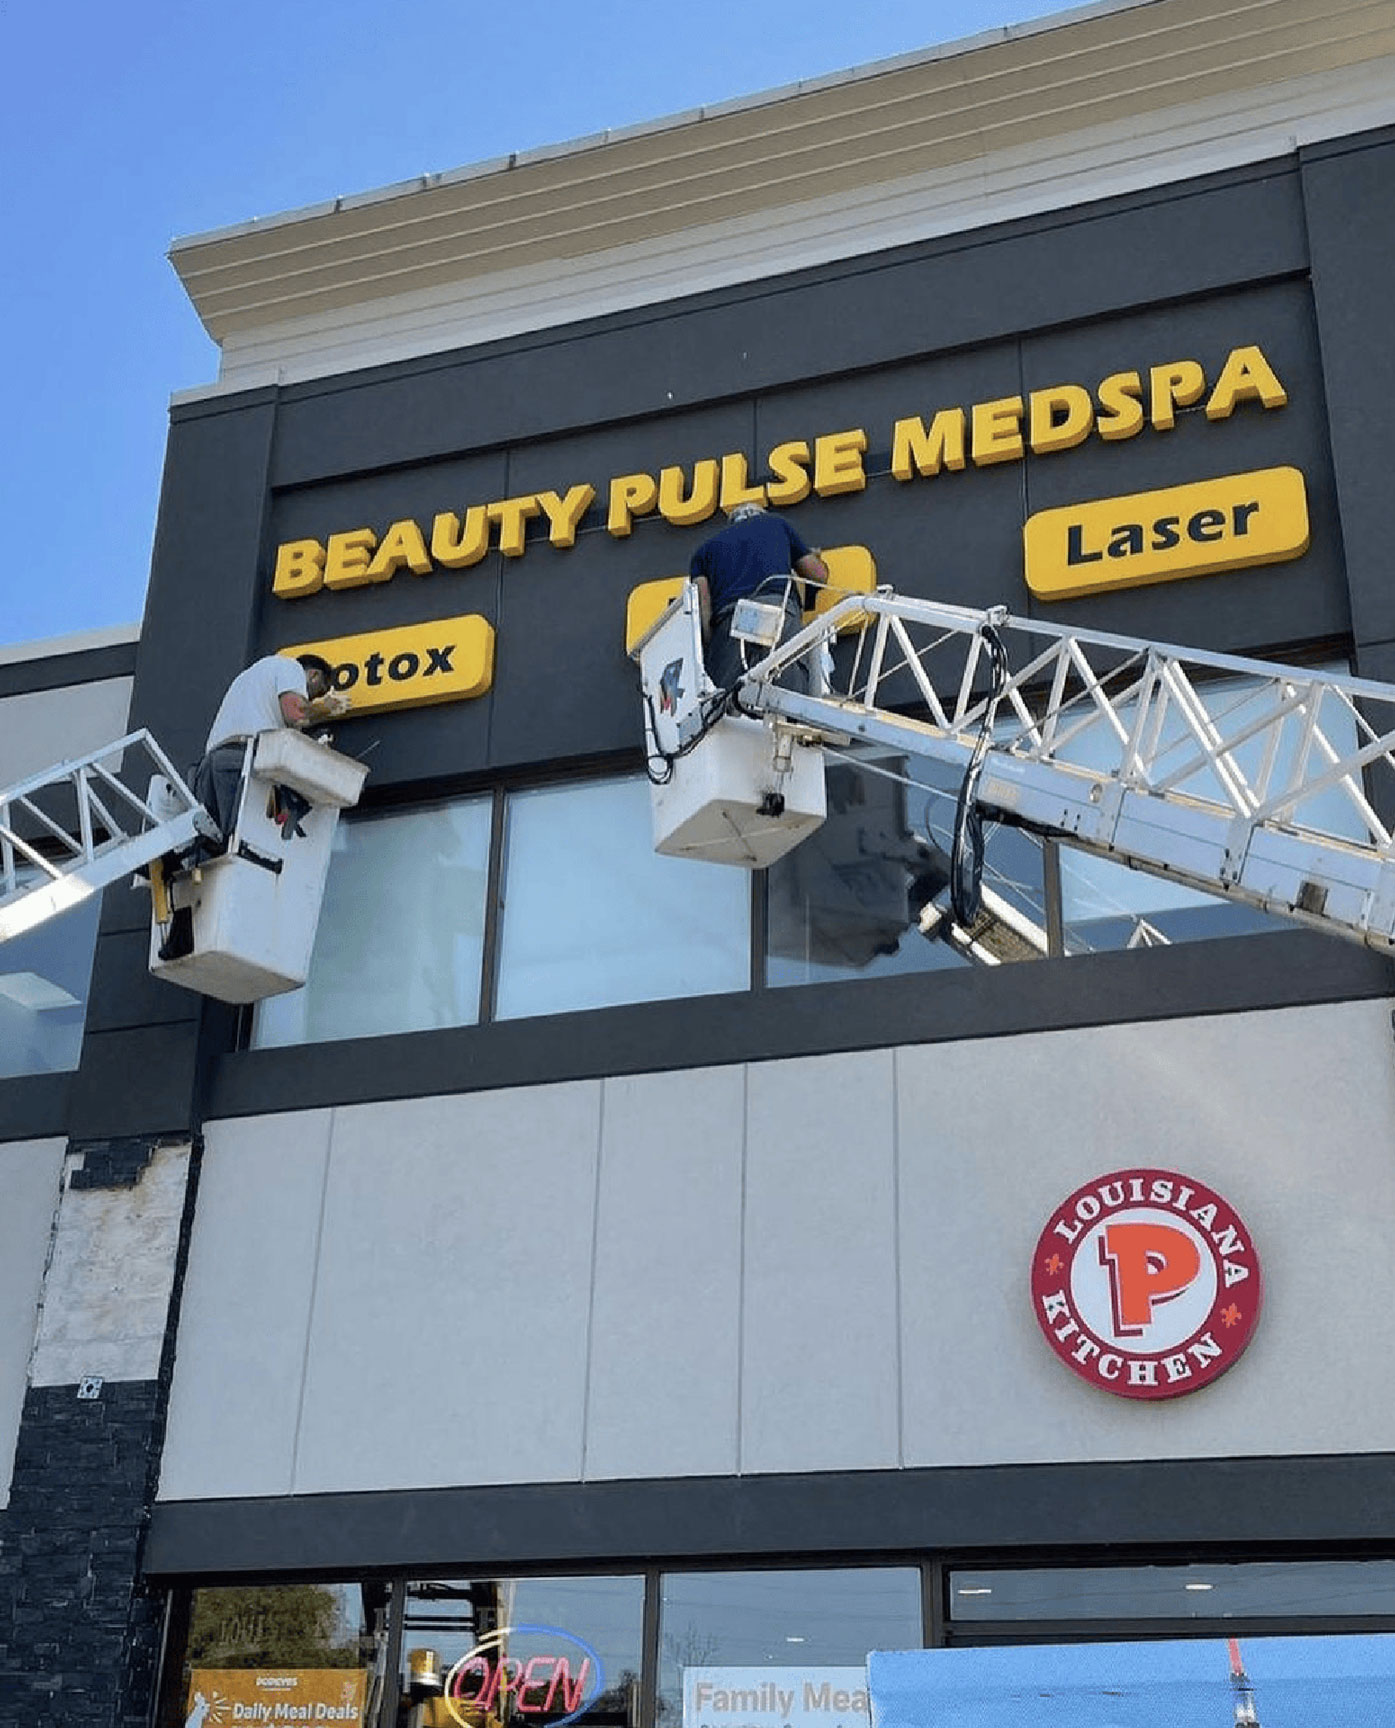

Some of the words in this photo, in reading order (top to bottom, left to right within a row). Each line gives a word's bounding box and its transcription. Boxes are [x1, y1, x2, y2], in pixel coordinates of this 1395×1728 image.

[272, 484, 595, 599] BEAUTY
[607, 428, 867, 537] PULSE
[892, 345, 1288, 481] MEDSPA
[1067, 501, 1260, 566] Laser
[331, 644, 457, 692] otox
[1053, 1178, 1249, 1288] LOUISIANA
[1097, 1221, 1202, 1338] P
[1042, 1289, 1222, 1386] KITCHEN
[233, 1702, 272, 1722] Daily
[274, 1702, 313, 1719] Meal
[315, 1702, 359, 1719] Deals
[453, 1656, 591, 1713] OPEN
[696, 1681, 795, 1719] Family
[803, 1681, 867, 1713] Mea
